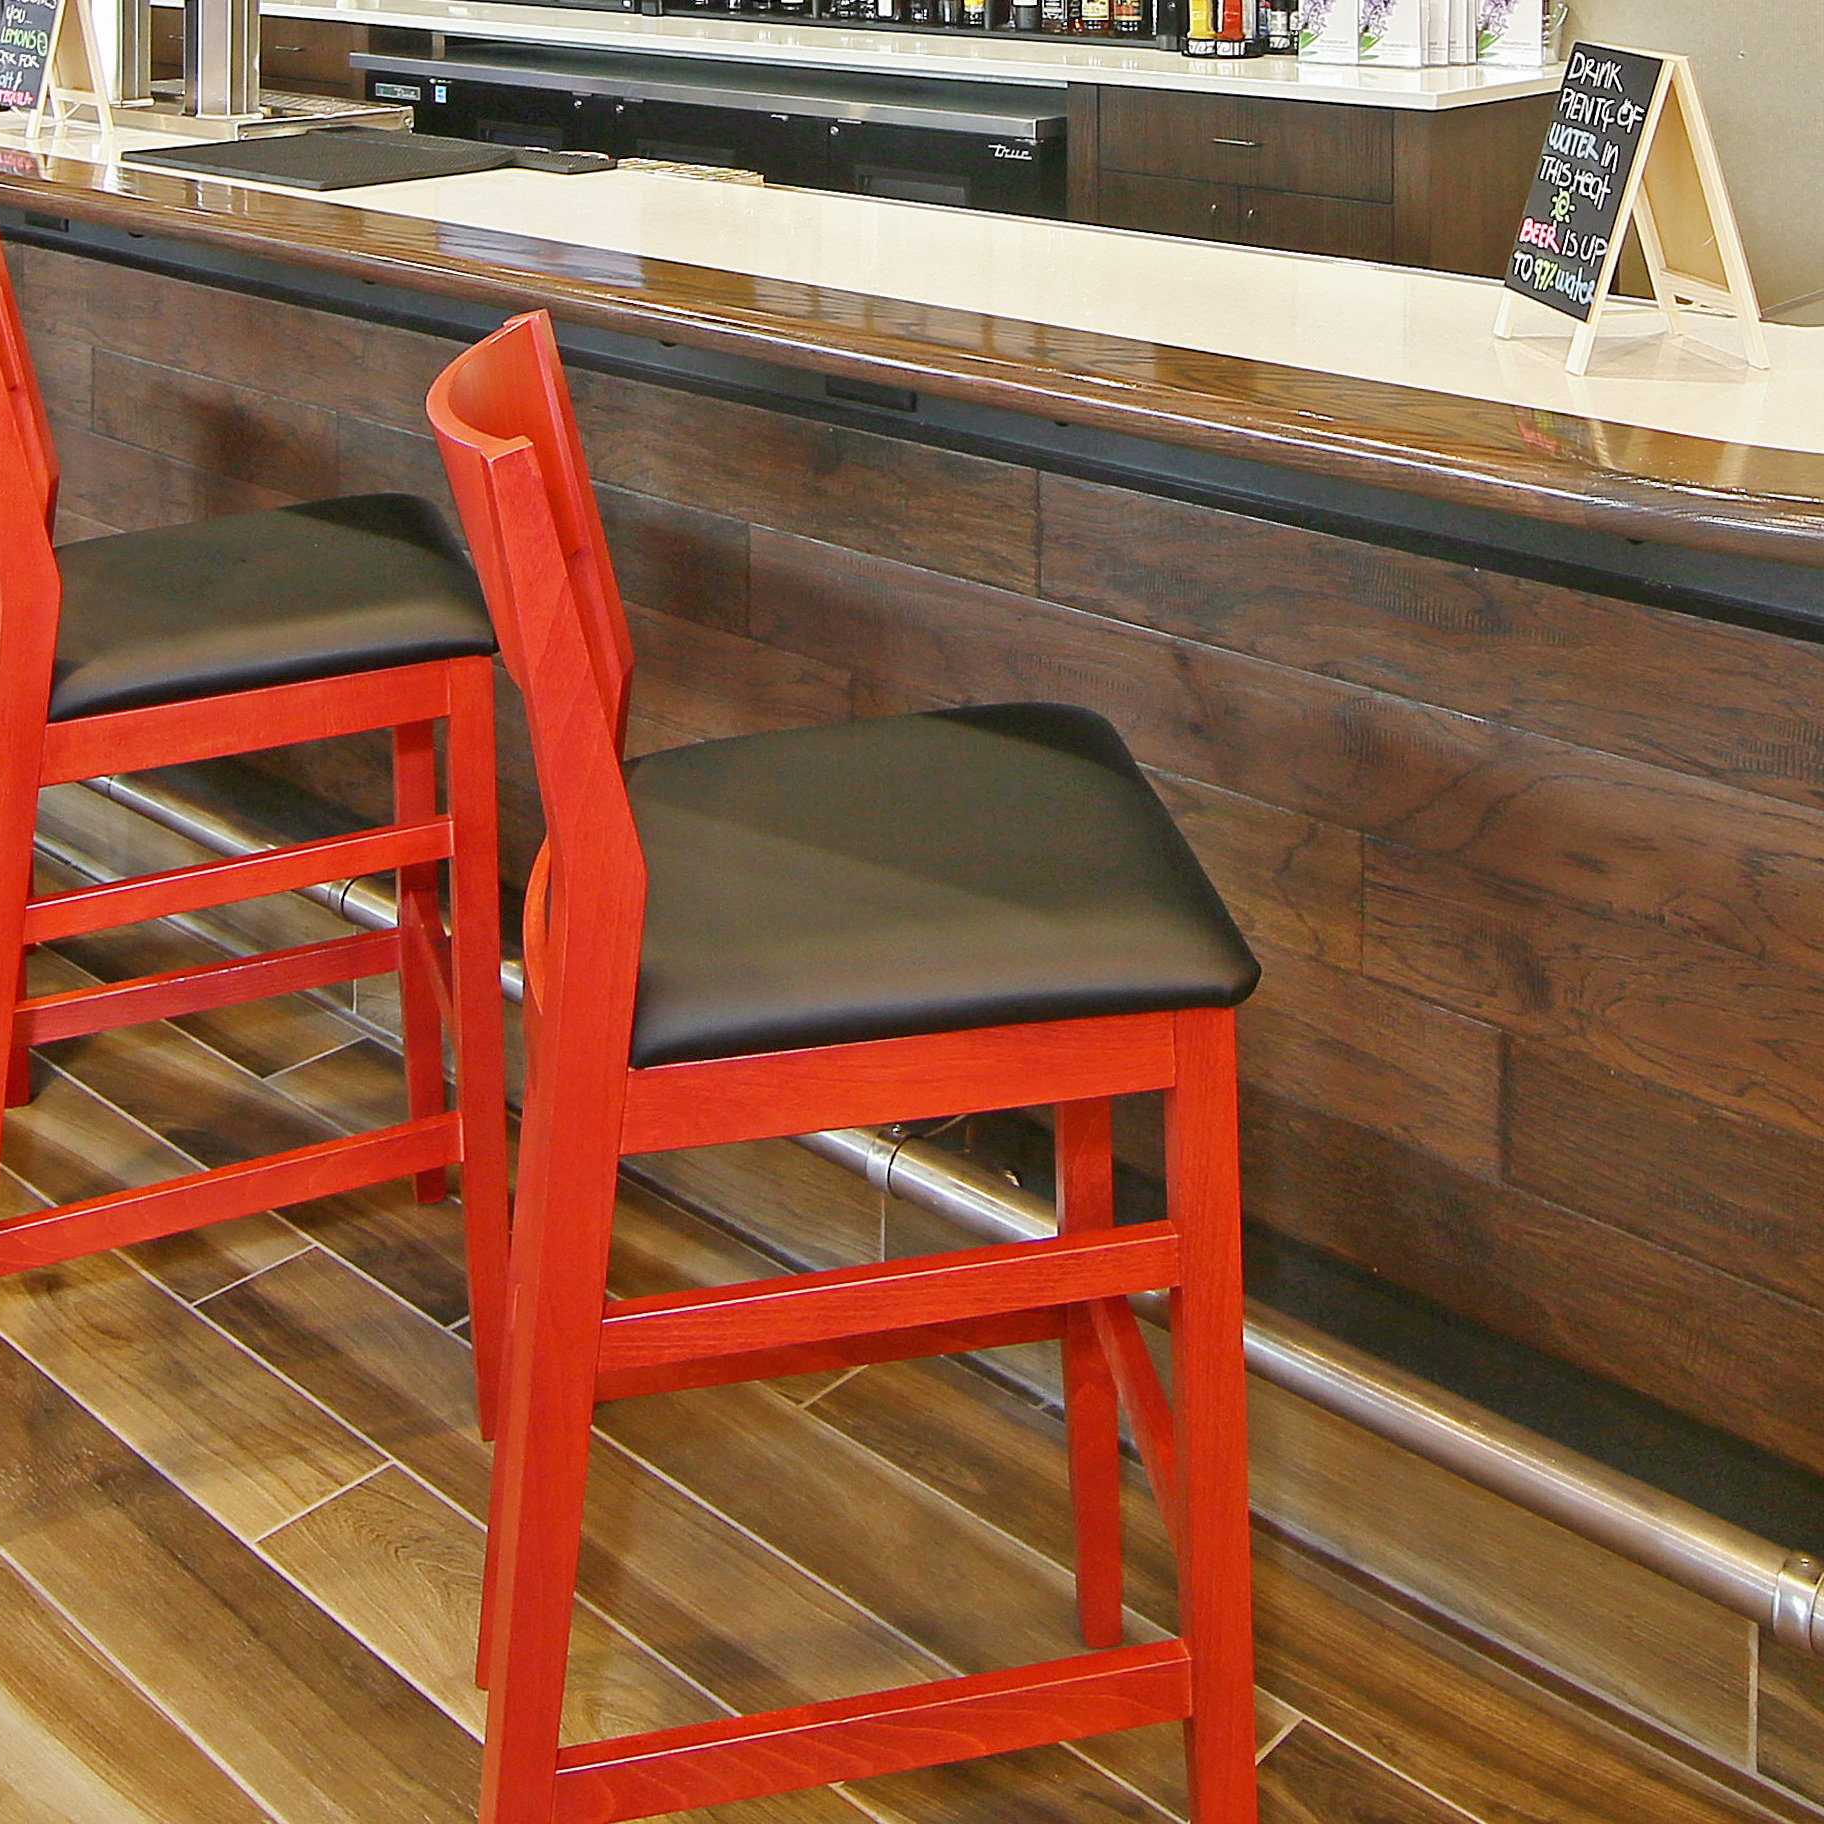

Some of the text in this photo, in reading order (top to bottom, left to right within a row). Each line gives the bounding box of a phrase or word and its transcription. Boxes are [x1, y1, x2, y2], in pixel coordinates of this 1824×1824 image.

[1518, 217, 1561, 254] BEER
[1579, 234, 1608, 267] UP
[1513, 249, 1534, 282] TO
